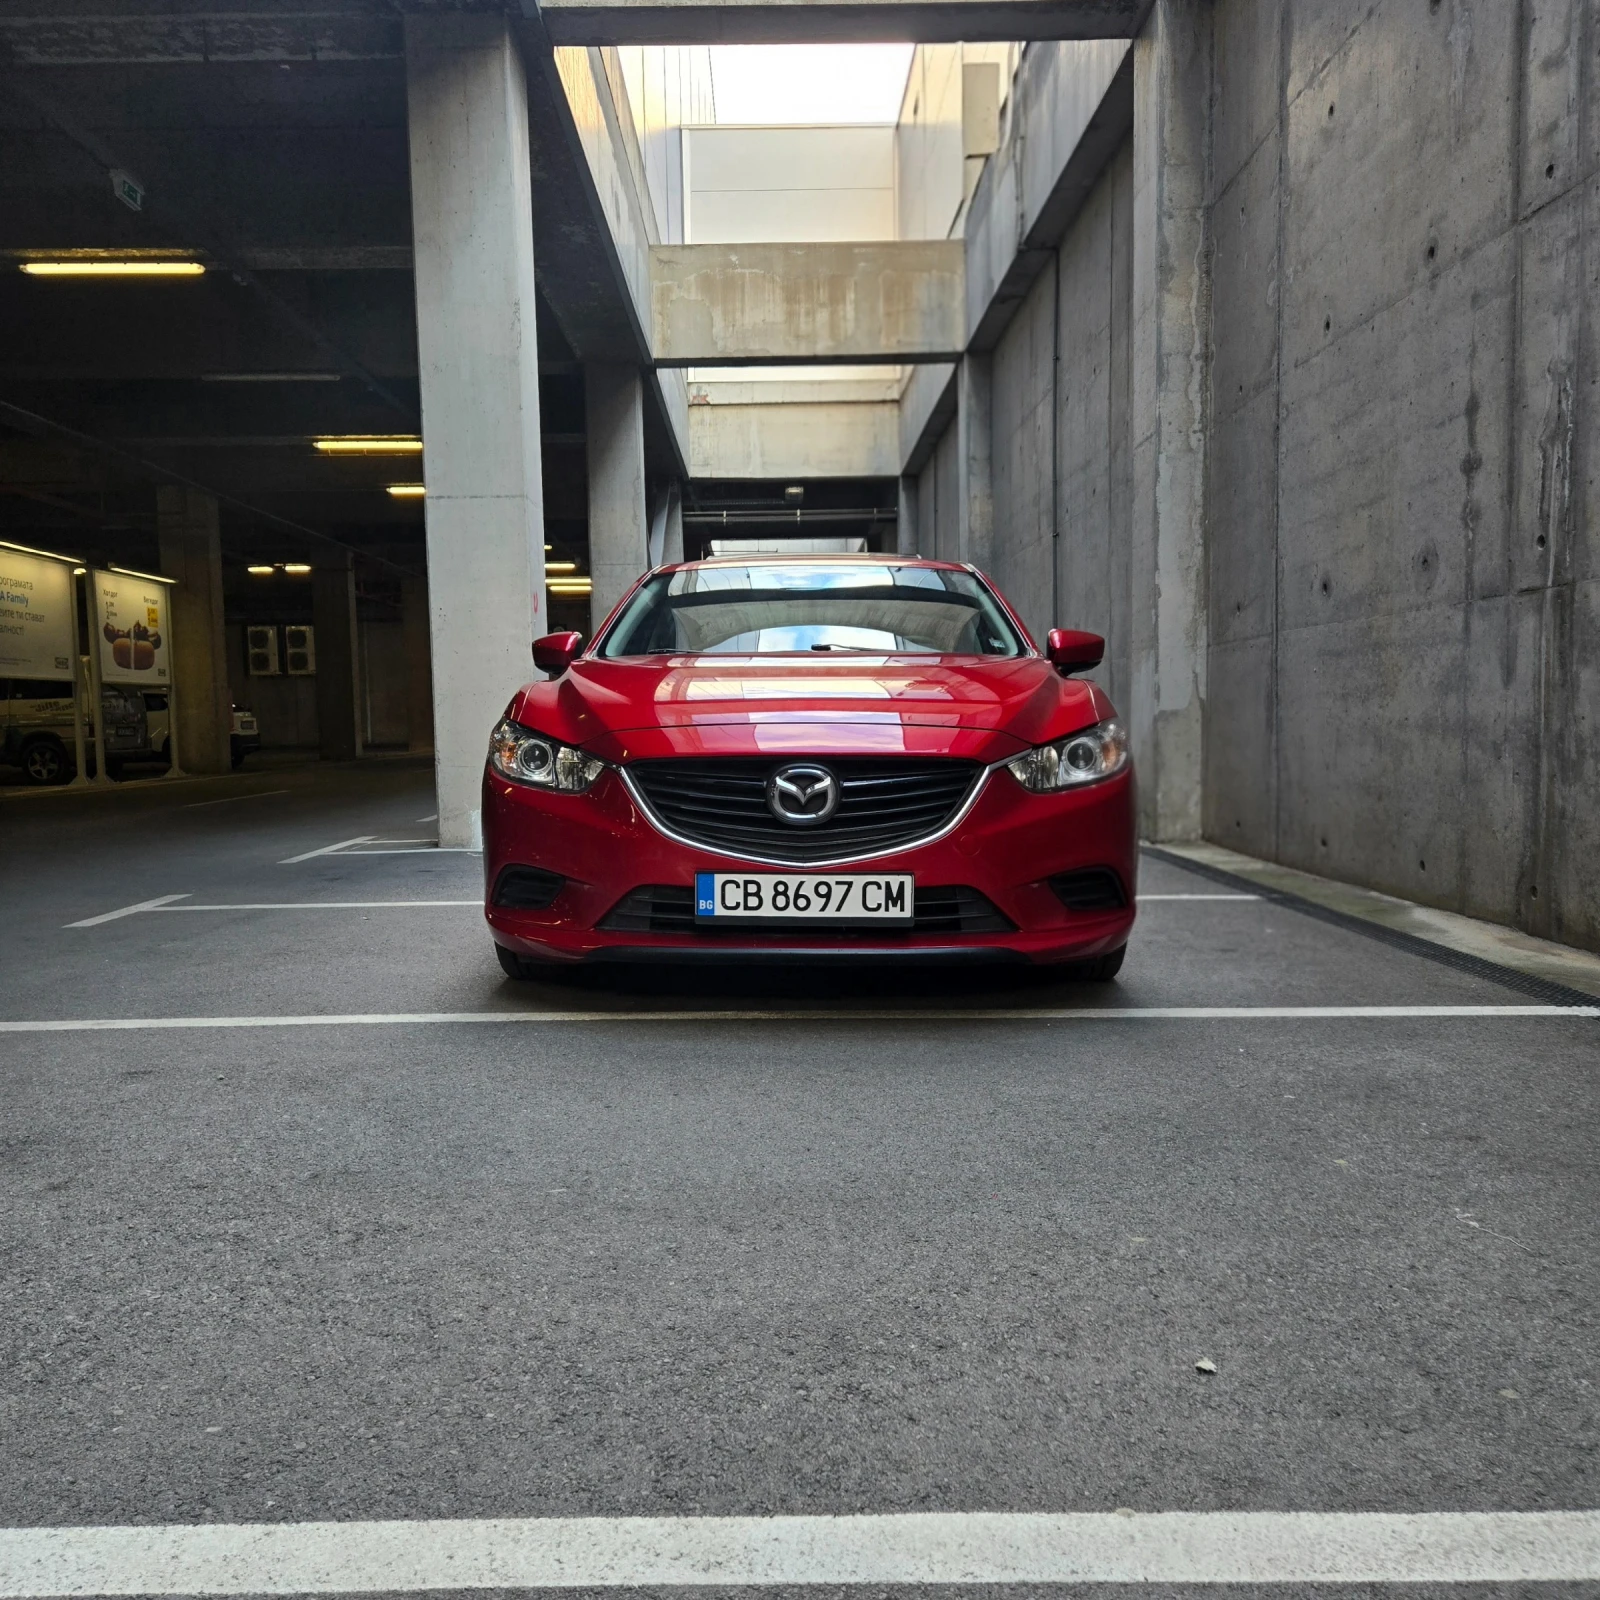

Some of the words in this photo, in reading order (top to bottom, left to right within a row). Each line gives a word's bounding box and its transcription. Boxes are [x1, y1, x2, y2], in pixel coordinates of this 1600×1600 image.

[6, 591, 29, 608] Family
[25, 611, 45, 623] стават
[720, 879, 764, 911] CB
[771, 880, 854, 912] 8697
[861, 880, 905, 912] CM
[699, 900, 713, 910] BG
